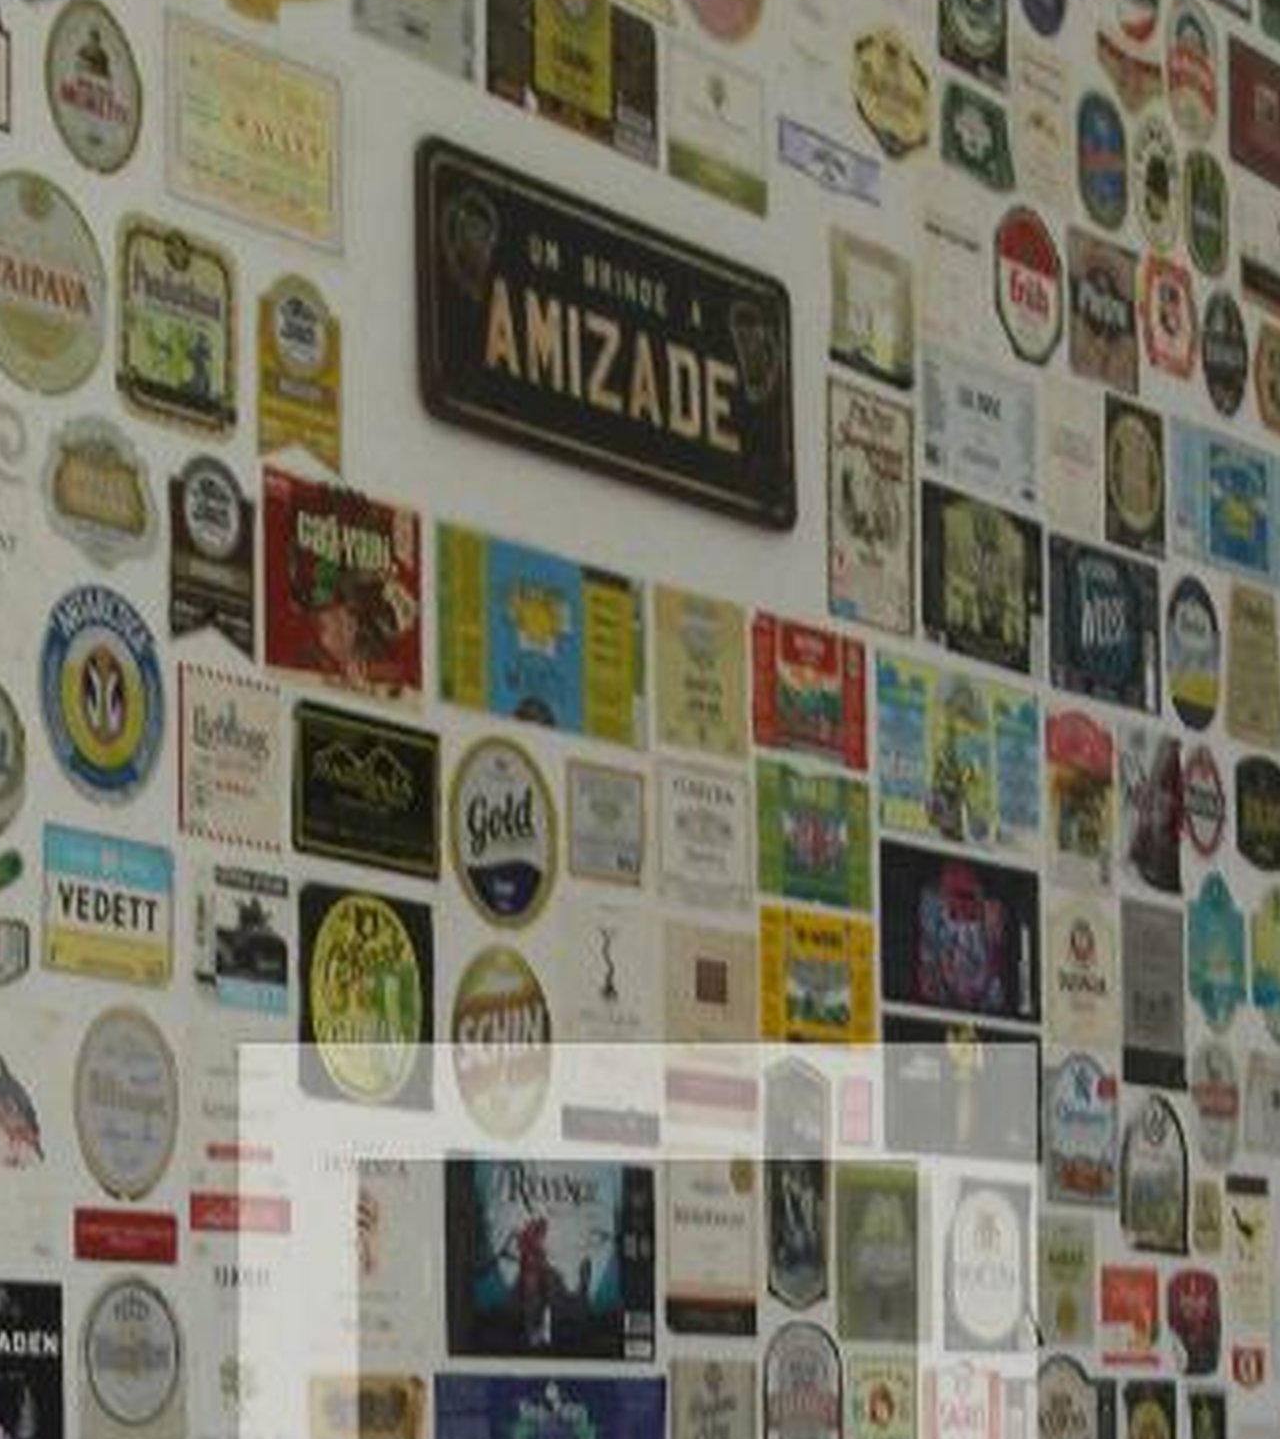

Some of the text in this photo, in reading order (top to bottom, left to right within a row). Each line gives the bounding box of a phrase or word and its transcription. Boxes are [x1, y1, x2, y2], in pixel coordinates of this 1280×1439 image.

[529, 236, 561, 273] UM
[581, 251, 669, 310] BRINDE
[484, 272, 742, 453] AMIZADE
[466, 791, 537, 858] Gold
[57, 878, 158, 933] VEDETT
